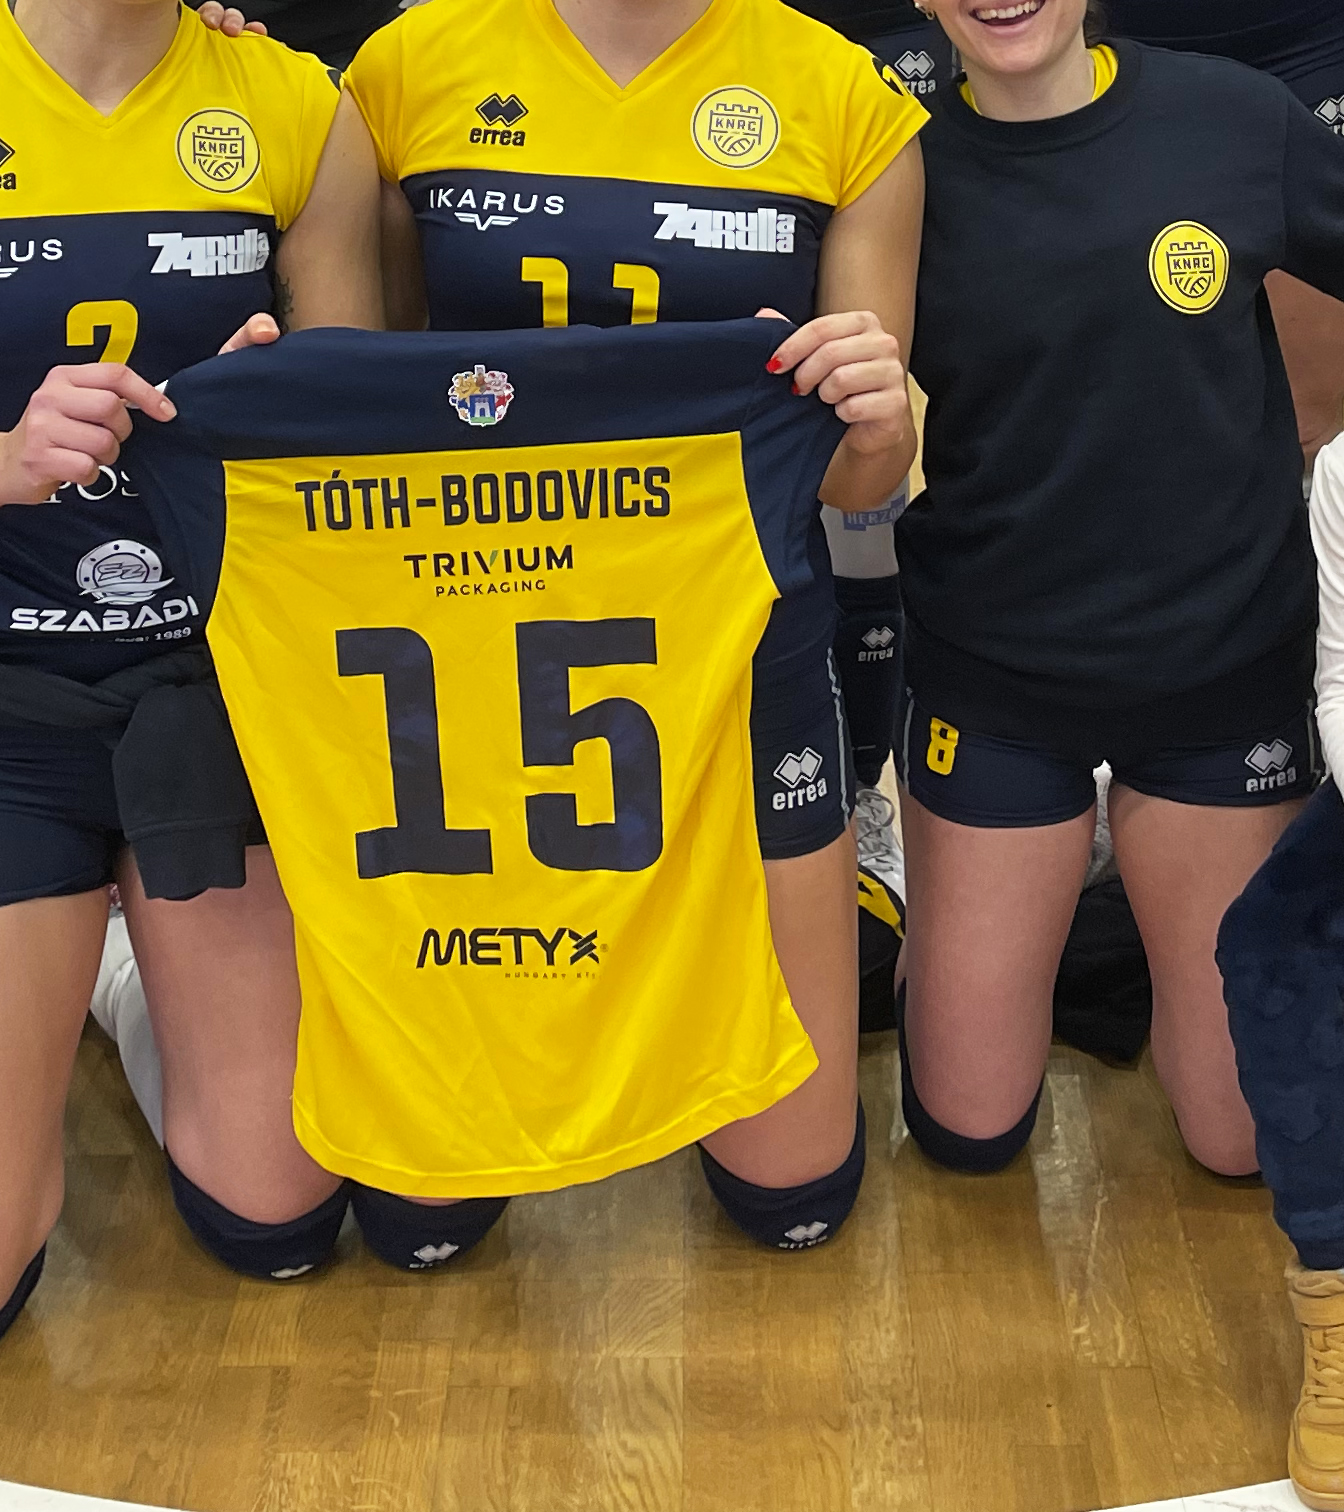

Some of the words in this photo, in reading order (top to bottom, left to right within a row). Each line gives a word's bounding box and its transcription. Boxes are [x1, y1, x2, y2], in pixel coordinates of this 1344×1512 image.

[468, 125, 526, 147] errea
[715, 117, 757, 133] KNRC
[198, 140, 239, 155] KNRC
[429, 188, 565, 215] IKARUS
[1173, 257, 1210, 270] KNRC
[294, 465, 671, 532] TÓTH-BODOVICS
[403, 544, 574, 580] TRIVIUM
[434, 579, 547, 598] PACKAGING
[335, 616, 664, 879] 15
[926, 716, 960, 776] 8
[1246, 763, 1298, 793] errea
[771, 777, 828, 811] errea
[415, 926, 600, 969] METYX
